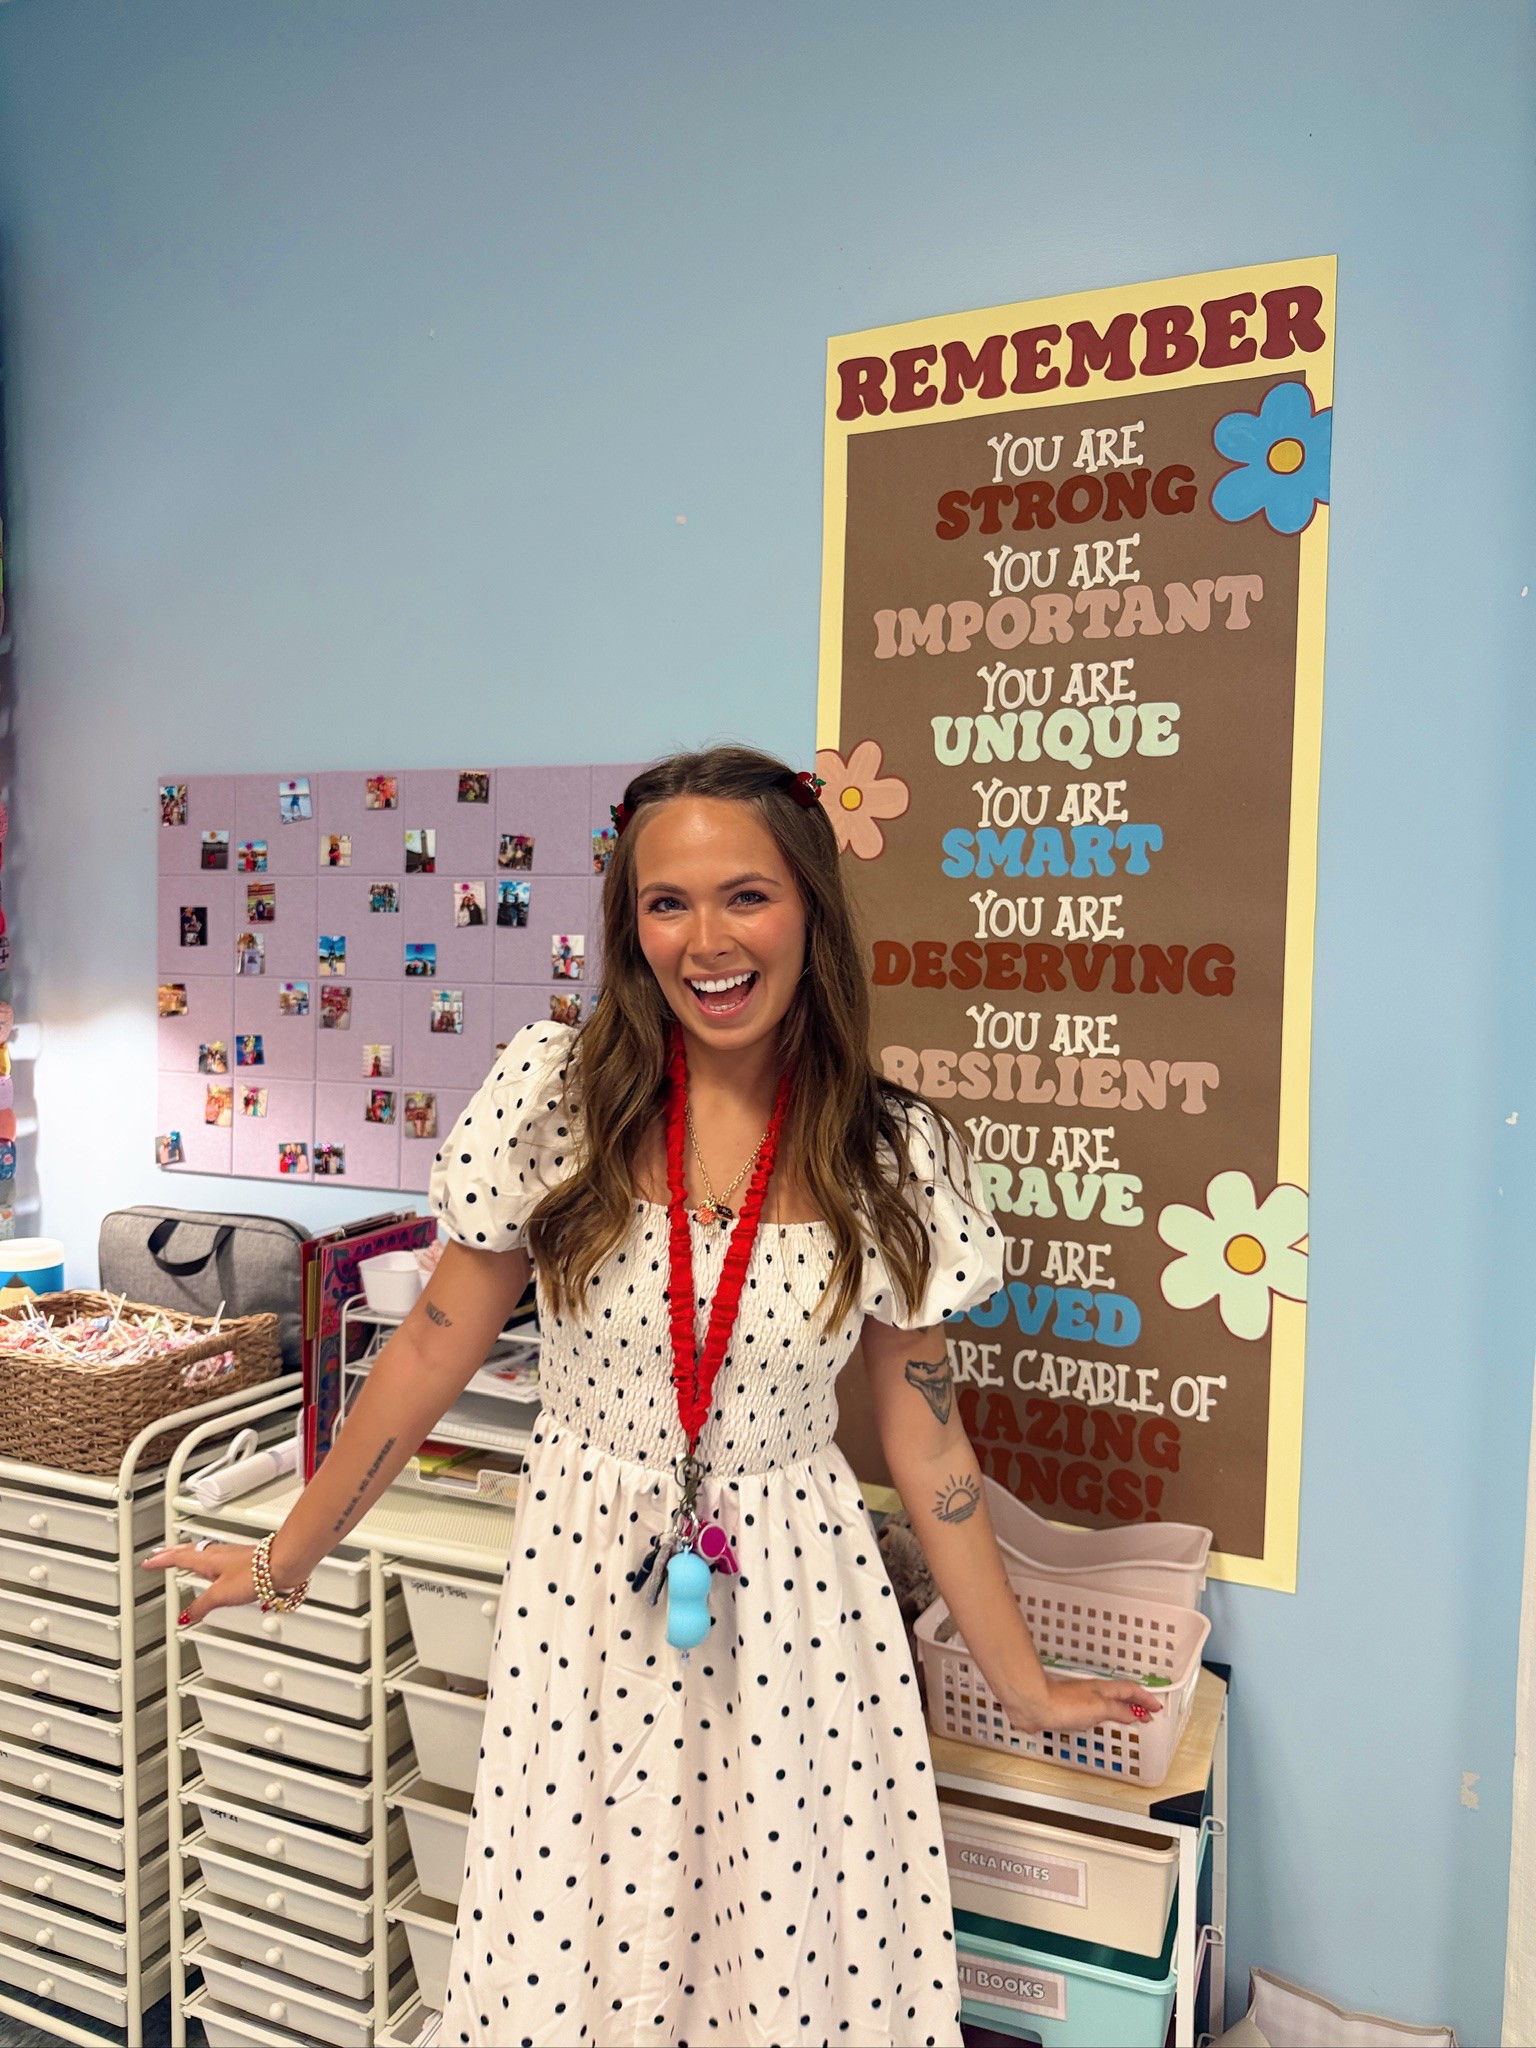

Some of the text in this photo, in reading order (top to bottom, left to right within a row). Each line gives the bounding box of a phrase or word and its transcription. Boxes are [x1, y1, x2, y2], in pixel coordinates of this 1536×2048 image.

[836, 285, 1326, 421] REMEMBER
[987, 420, 1145, 483] YOU ARE
[934, 464, 1198, 541] STRONG
[983, 533, 1140, 597] YOU ARE
[873, 574, 1263, 659] IMPORTANT
[976, 658, 1136, 713] YOU ARE
[930, 702, 1181, 770] UNIQUE
[971, 777, 1129, 829] YOU ARE
[940, 823, 1163, 879] SMART
[968, 889, 1125, 942] YOU ARE
[871, 940, 1236, 997] DESERVING
[965, 1002, 1120, 1058] YOU ARE
[879, 1045, 1220, 1114] RESILIENT
[964, 1115, 1120, 1174] YOU ARE
[974, 1162, 1144, 1227] RAVE
[1040, 1240, 1116, 1290] ARE
[942, 1281, 1141, 1347] OVED
[946, 1340, 1227, 1422] ARE CAPABLE OF
[960, 1850, 1050, 1881] CKLA NOTES
[976, 1969, 1045, 1999] BOOKS
